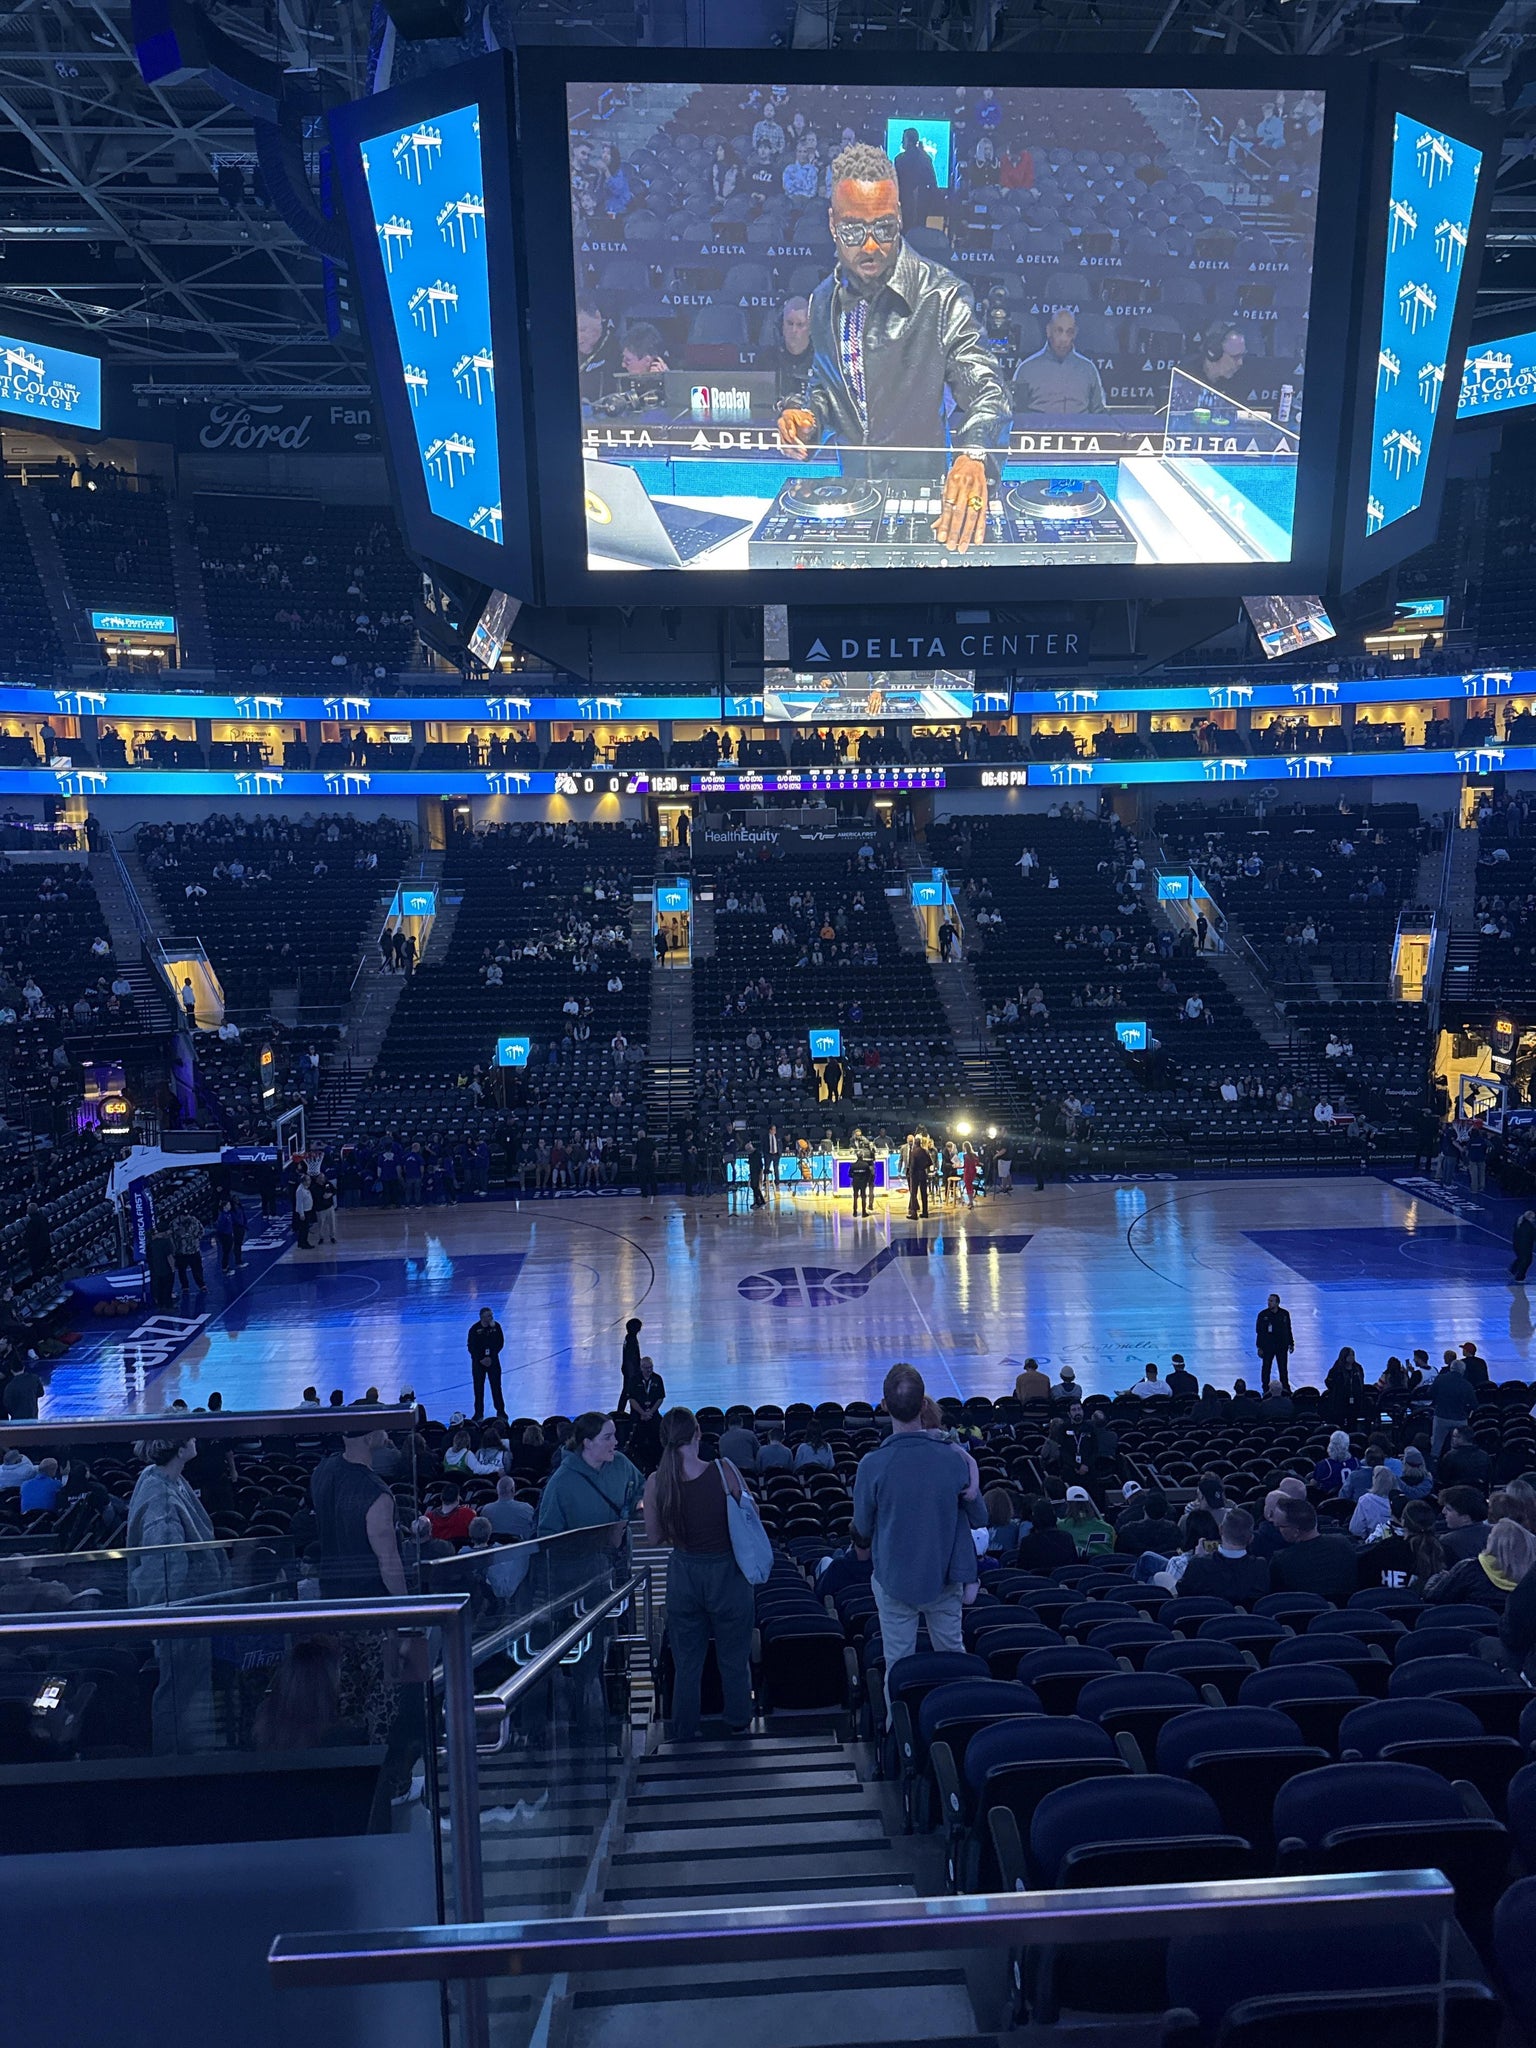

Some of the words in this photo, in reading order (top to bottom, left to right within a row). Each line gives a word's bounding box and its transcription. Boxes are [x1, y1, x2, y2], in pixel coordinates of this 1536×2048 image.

[592, 242, 628, 252] DELTA
[711, 245, 746, 255] DELTA
[778, 246, 812, 256] DELTA
[961, 253, 995, 262] DELTA
[1027, 255, 1060, 264] DELTA
[1090, 257, 1122, 266] DELTA
[1199, 260, 1230, 270] DELTA
[1258, 262, 1289, 272] DELTA
[673, 295, 713, 306] DELTA
[13, 375, 81, 403] COLONY
[1482, 373, 1536, 393] COLON
[1, 388, 72, 411] RTGAGE
[1111, 387, 1154, 398] DELTA
[330, 406, 371, 425] Fan
[200, 403, 313, 449] Ford
[586, 430, 653, 448] ELTA
[1020, 435, 1100, 452] DELTA
[1164, 437, 1237, 452] DELTA
[842, 637, 946, 658] DELTA
[960, 634, 1079, 657] CENTER
[584, 778, 594, 792] 0
[609, 777, 619, 792] 0
[651, 776, 678, 792] 16:50
[982, 772, 1009, 786] 06:46
[1010, 771, 1026, 785] PM
[705, 830, 778, 843] HealthEquity
[1089, 1173, 1179, 1182] PACS
[554, 1188, 642, 1198] PACS
[134, 1192, 144, 1217] FIRST
[137, 1217, 146, 1255] AMERICA
